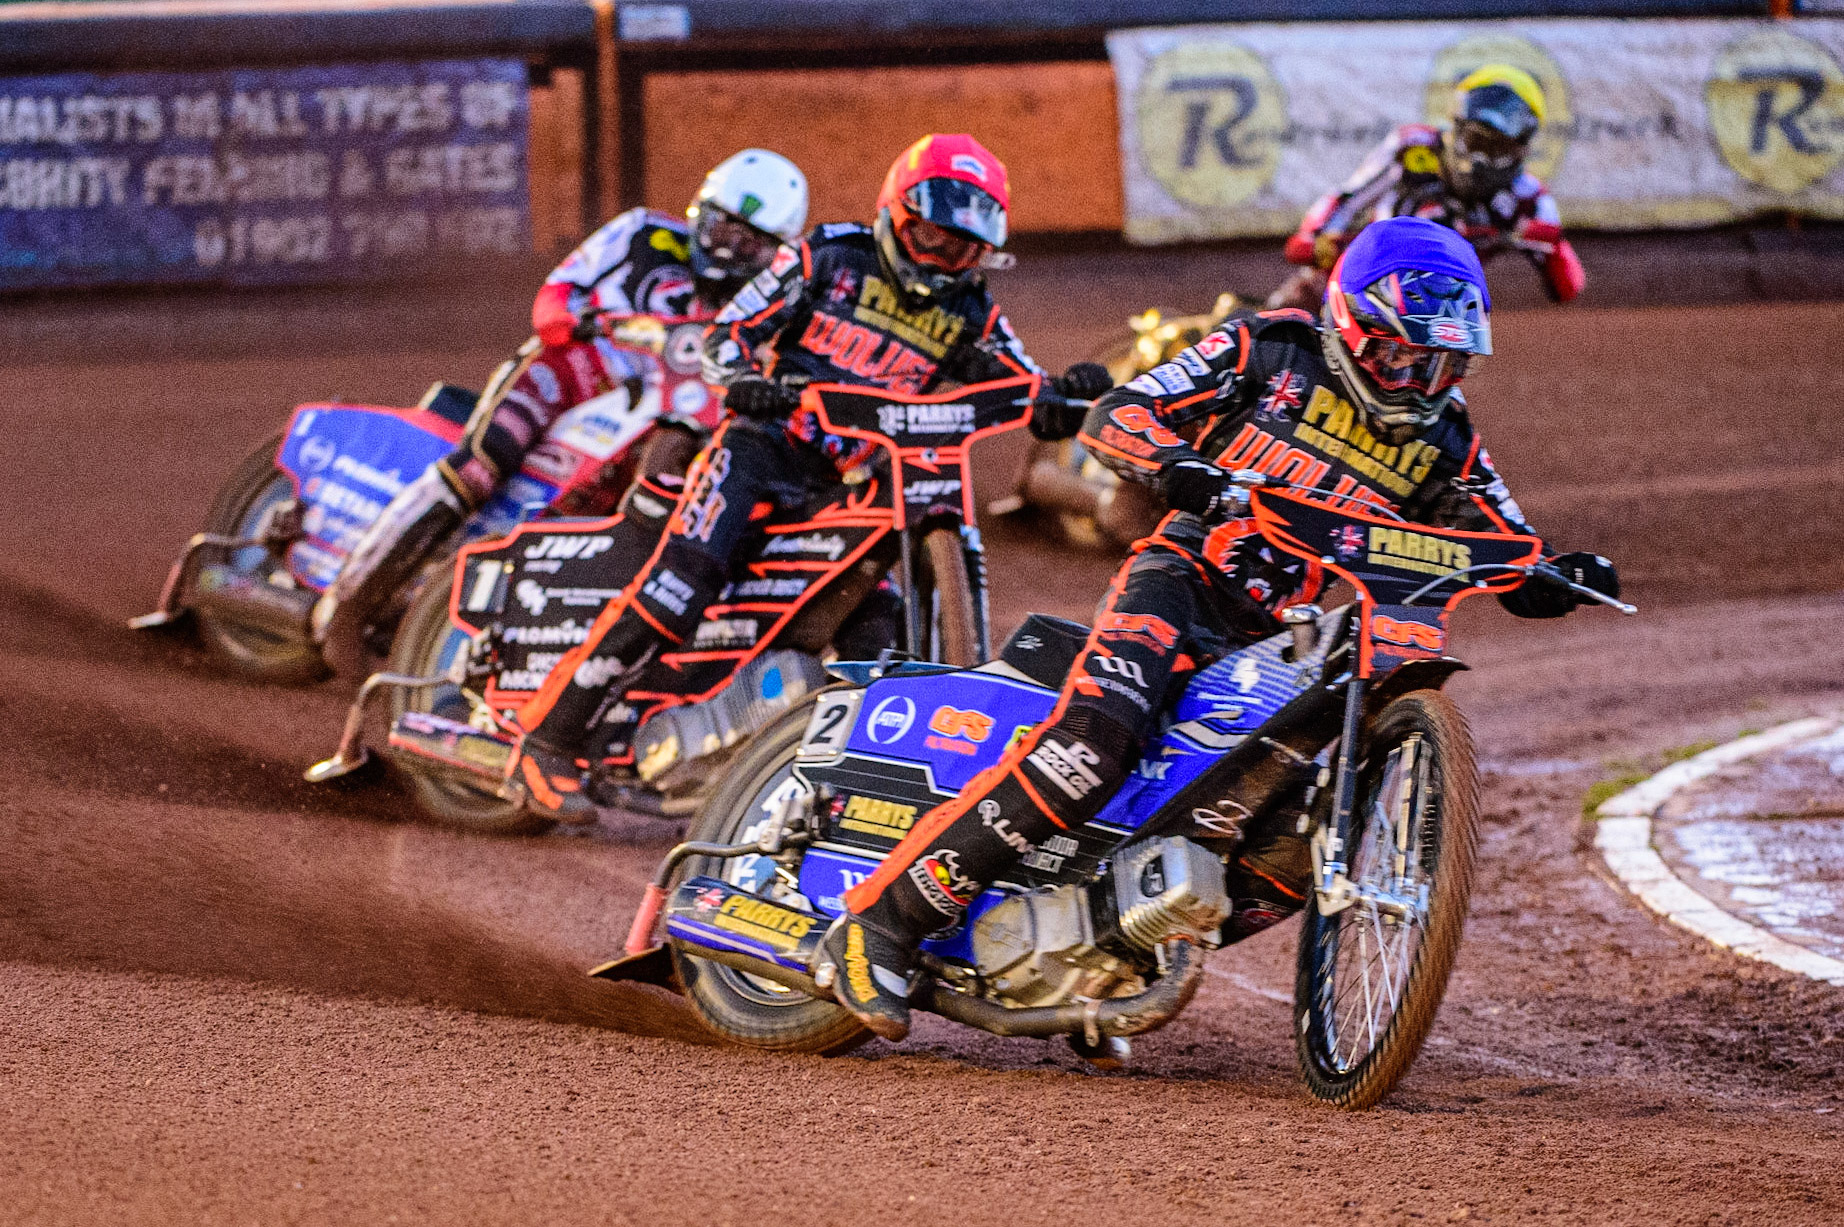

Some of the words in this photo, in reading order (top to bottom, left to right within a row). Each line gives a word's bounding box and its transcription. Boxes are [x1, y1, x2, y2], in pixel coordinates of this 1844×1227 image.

[316, 82, 449, 136] TYPES
[858, 274, 966, 346] PARYS
[1212, 421, 1402, 522] WOLVE
[524, 534, 615, 560] JWP
[1368, 526, 1473, 570] PARRYS
[466, 560, 503, 612] 1
[808, 703, 848, 745] 2
[842, 794, 918, 831] PARRYS
[720, 894, 818, 939] PARRYS
